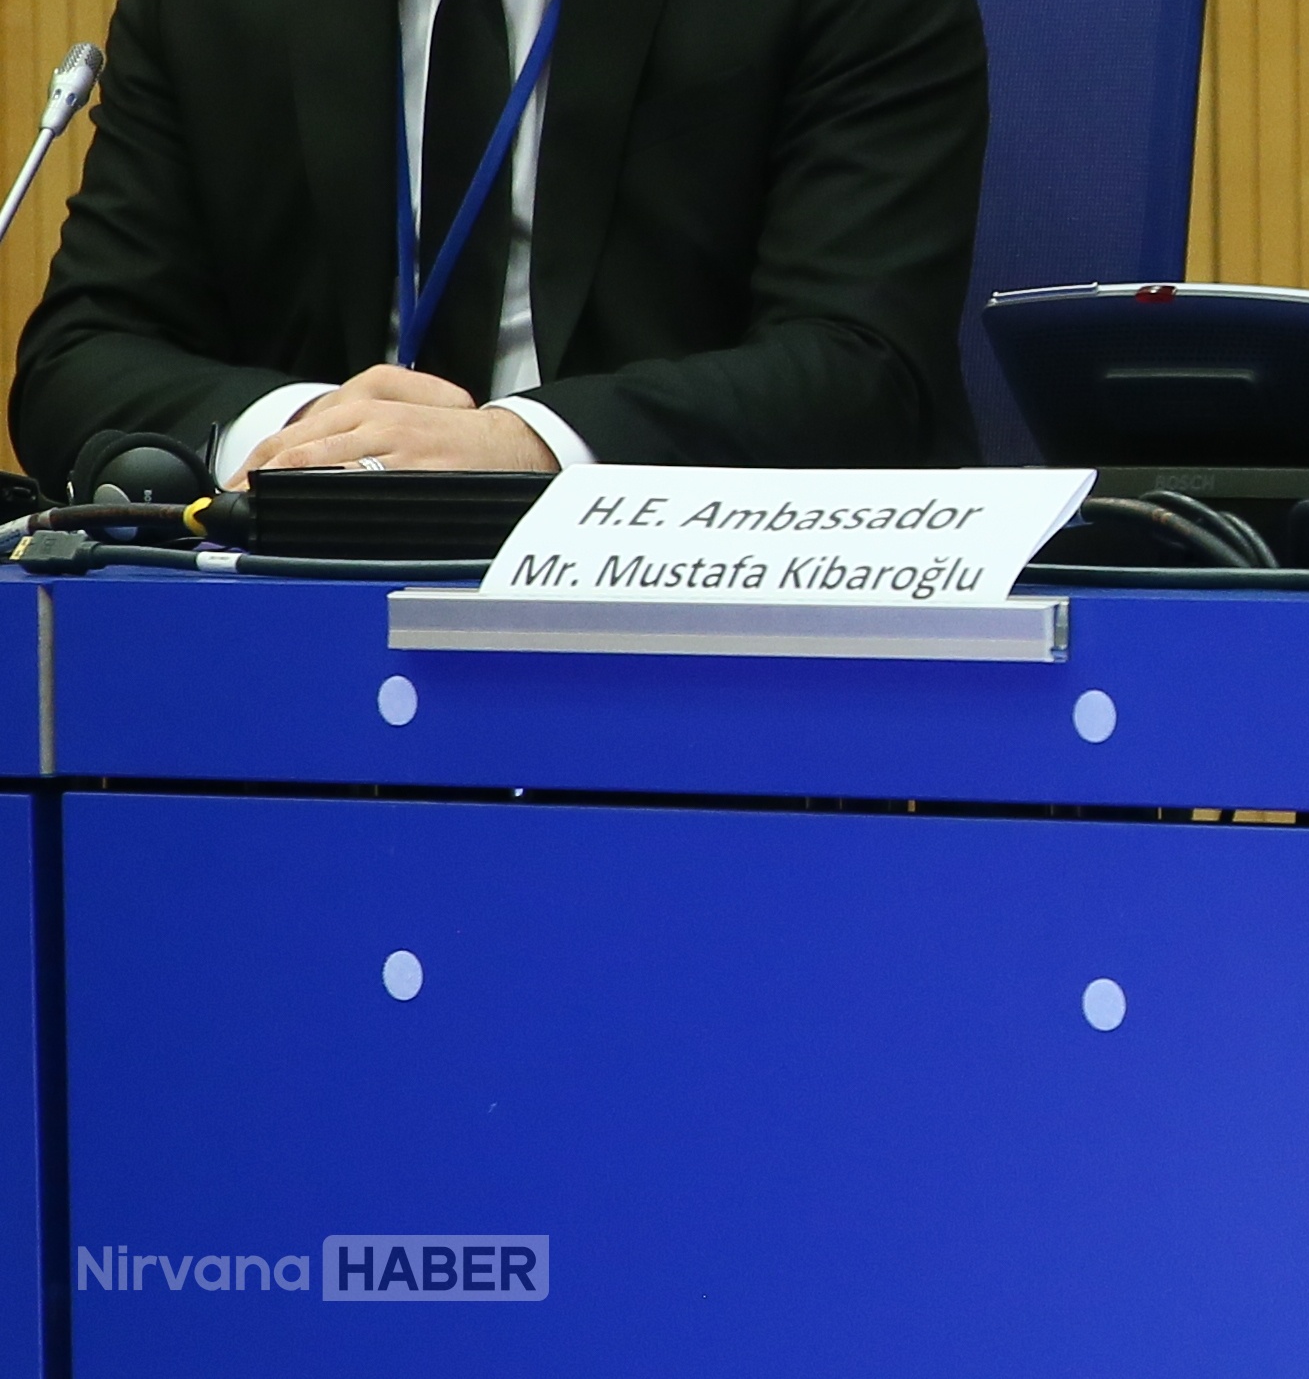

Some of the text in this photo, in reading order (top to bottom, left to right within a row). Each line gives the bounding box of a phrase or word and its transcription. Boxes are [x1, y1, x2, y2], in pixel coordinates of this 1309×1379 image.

[579, 496, 983, 531] H.E. Ambassador
[510, 554, 983, 601] Mr. Mustafa Kibaroğlu
